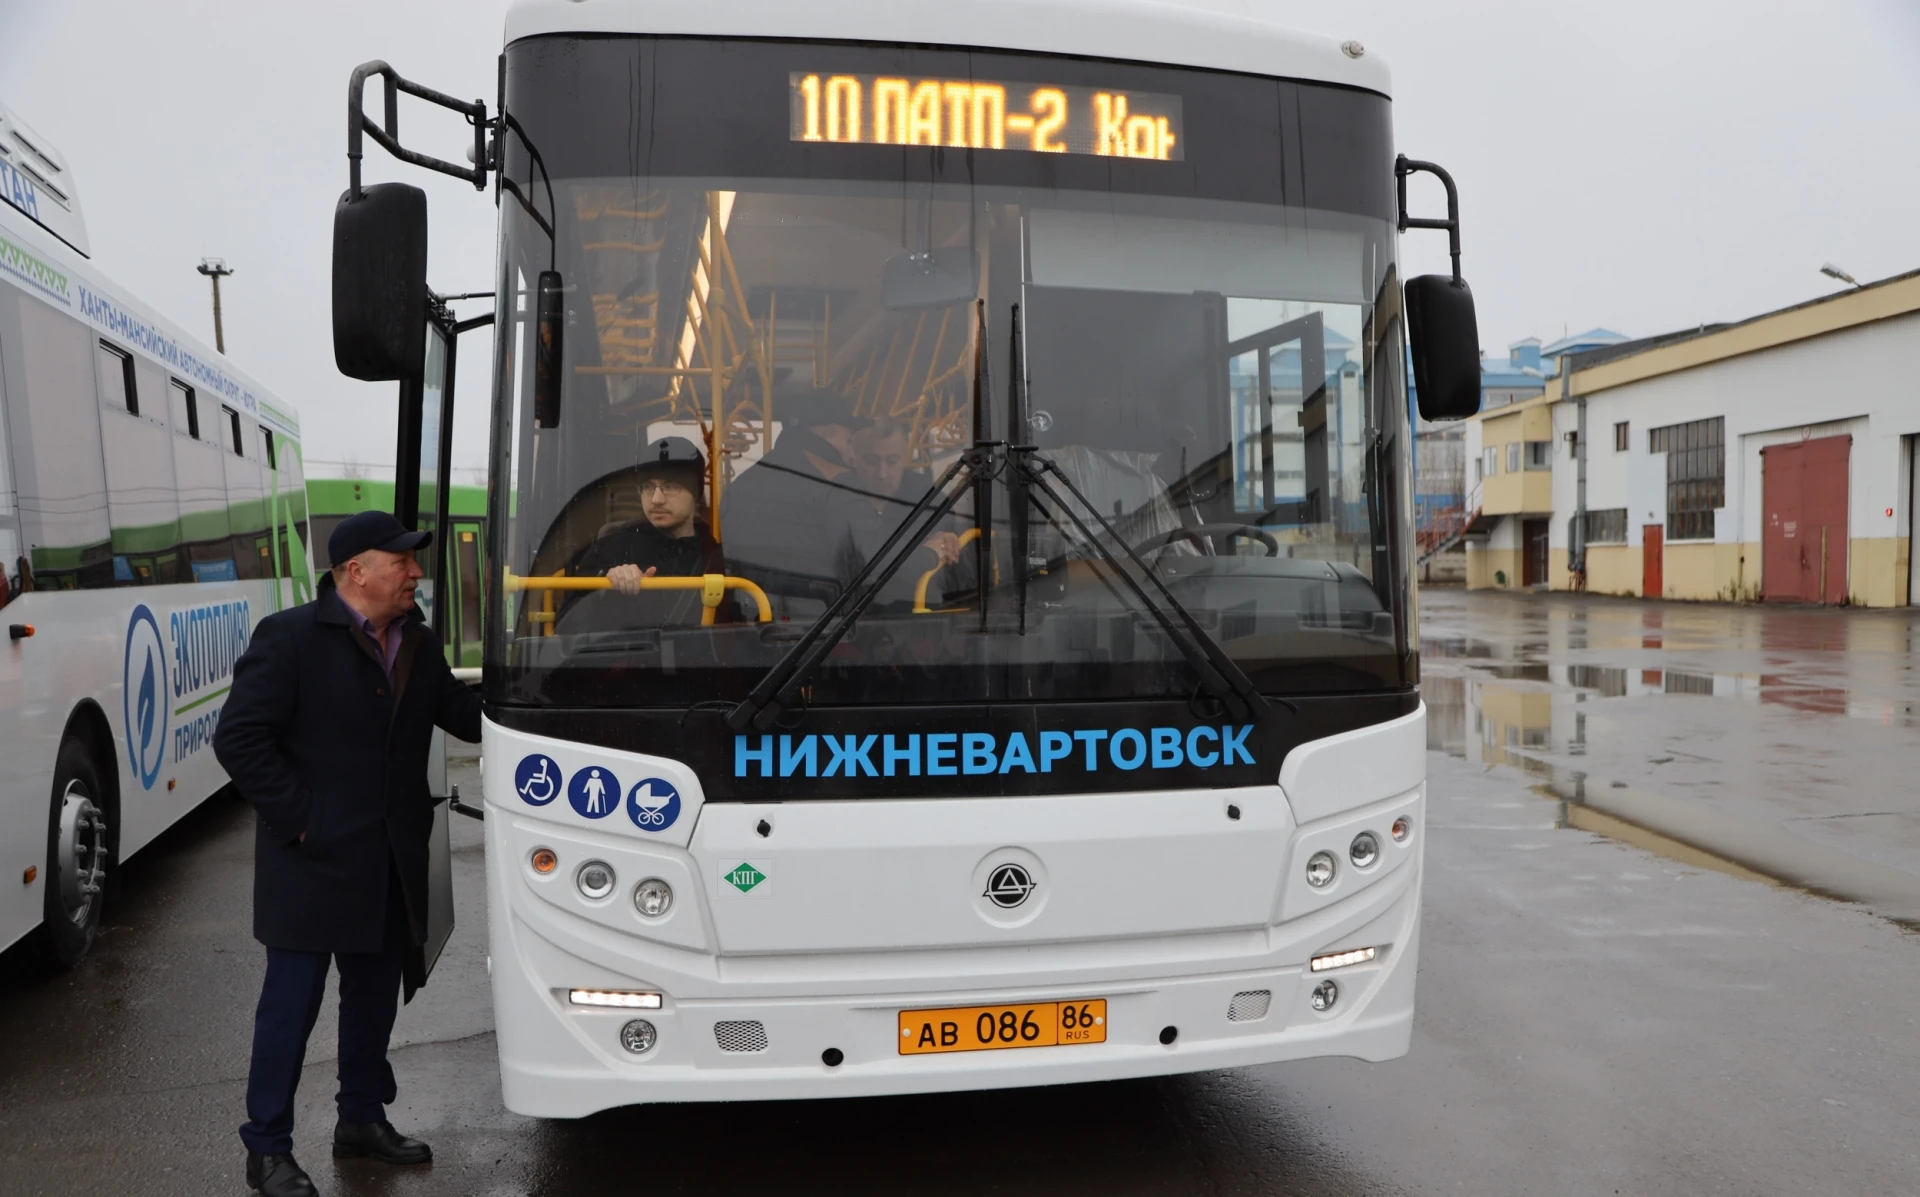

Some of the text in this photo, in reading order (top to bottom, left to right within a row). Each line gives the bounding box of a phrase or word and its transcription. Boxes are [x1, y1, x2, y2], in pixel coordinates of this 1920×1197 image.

[801, 74, 861, 141] 10
[872, 77, 1067, 153] ПАТП-2
[78, 284, 178, 367] ХАНТЫ-МАНСИЙСКИЙ
[180, 349, 223, 392] АВТОНОМНЫЙ
[171, 600, 250, 697] ЭКОТОПЛИВО
[735, 725, 1256, 778] НИЖНЕВАРТОВСК
[732, 870, 759, 885] КПГ
[917, 1004, 1094, 1048] АВ 086 86
[1065, 1030, 1090, 1040] RUS
